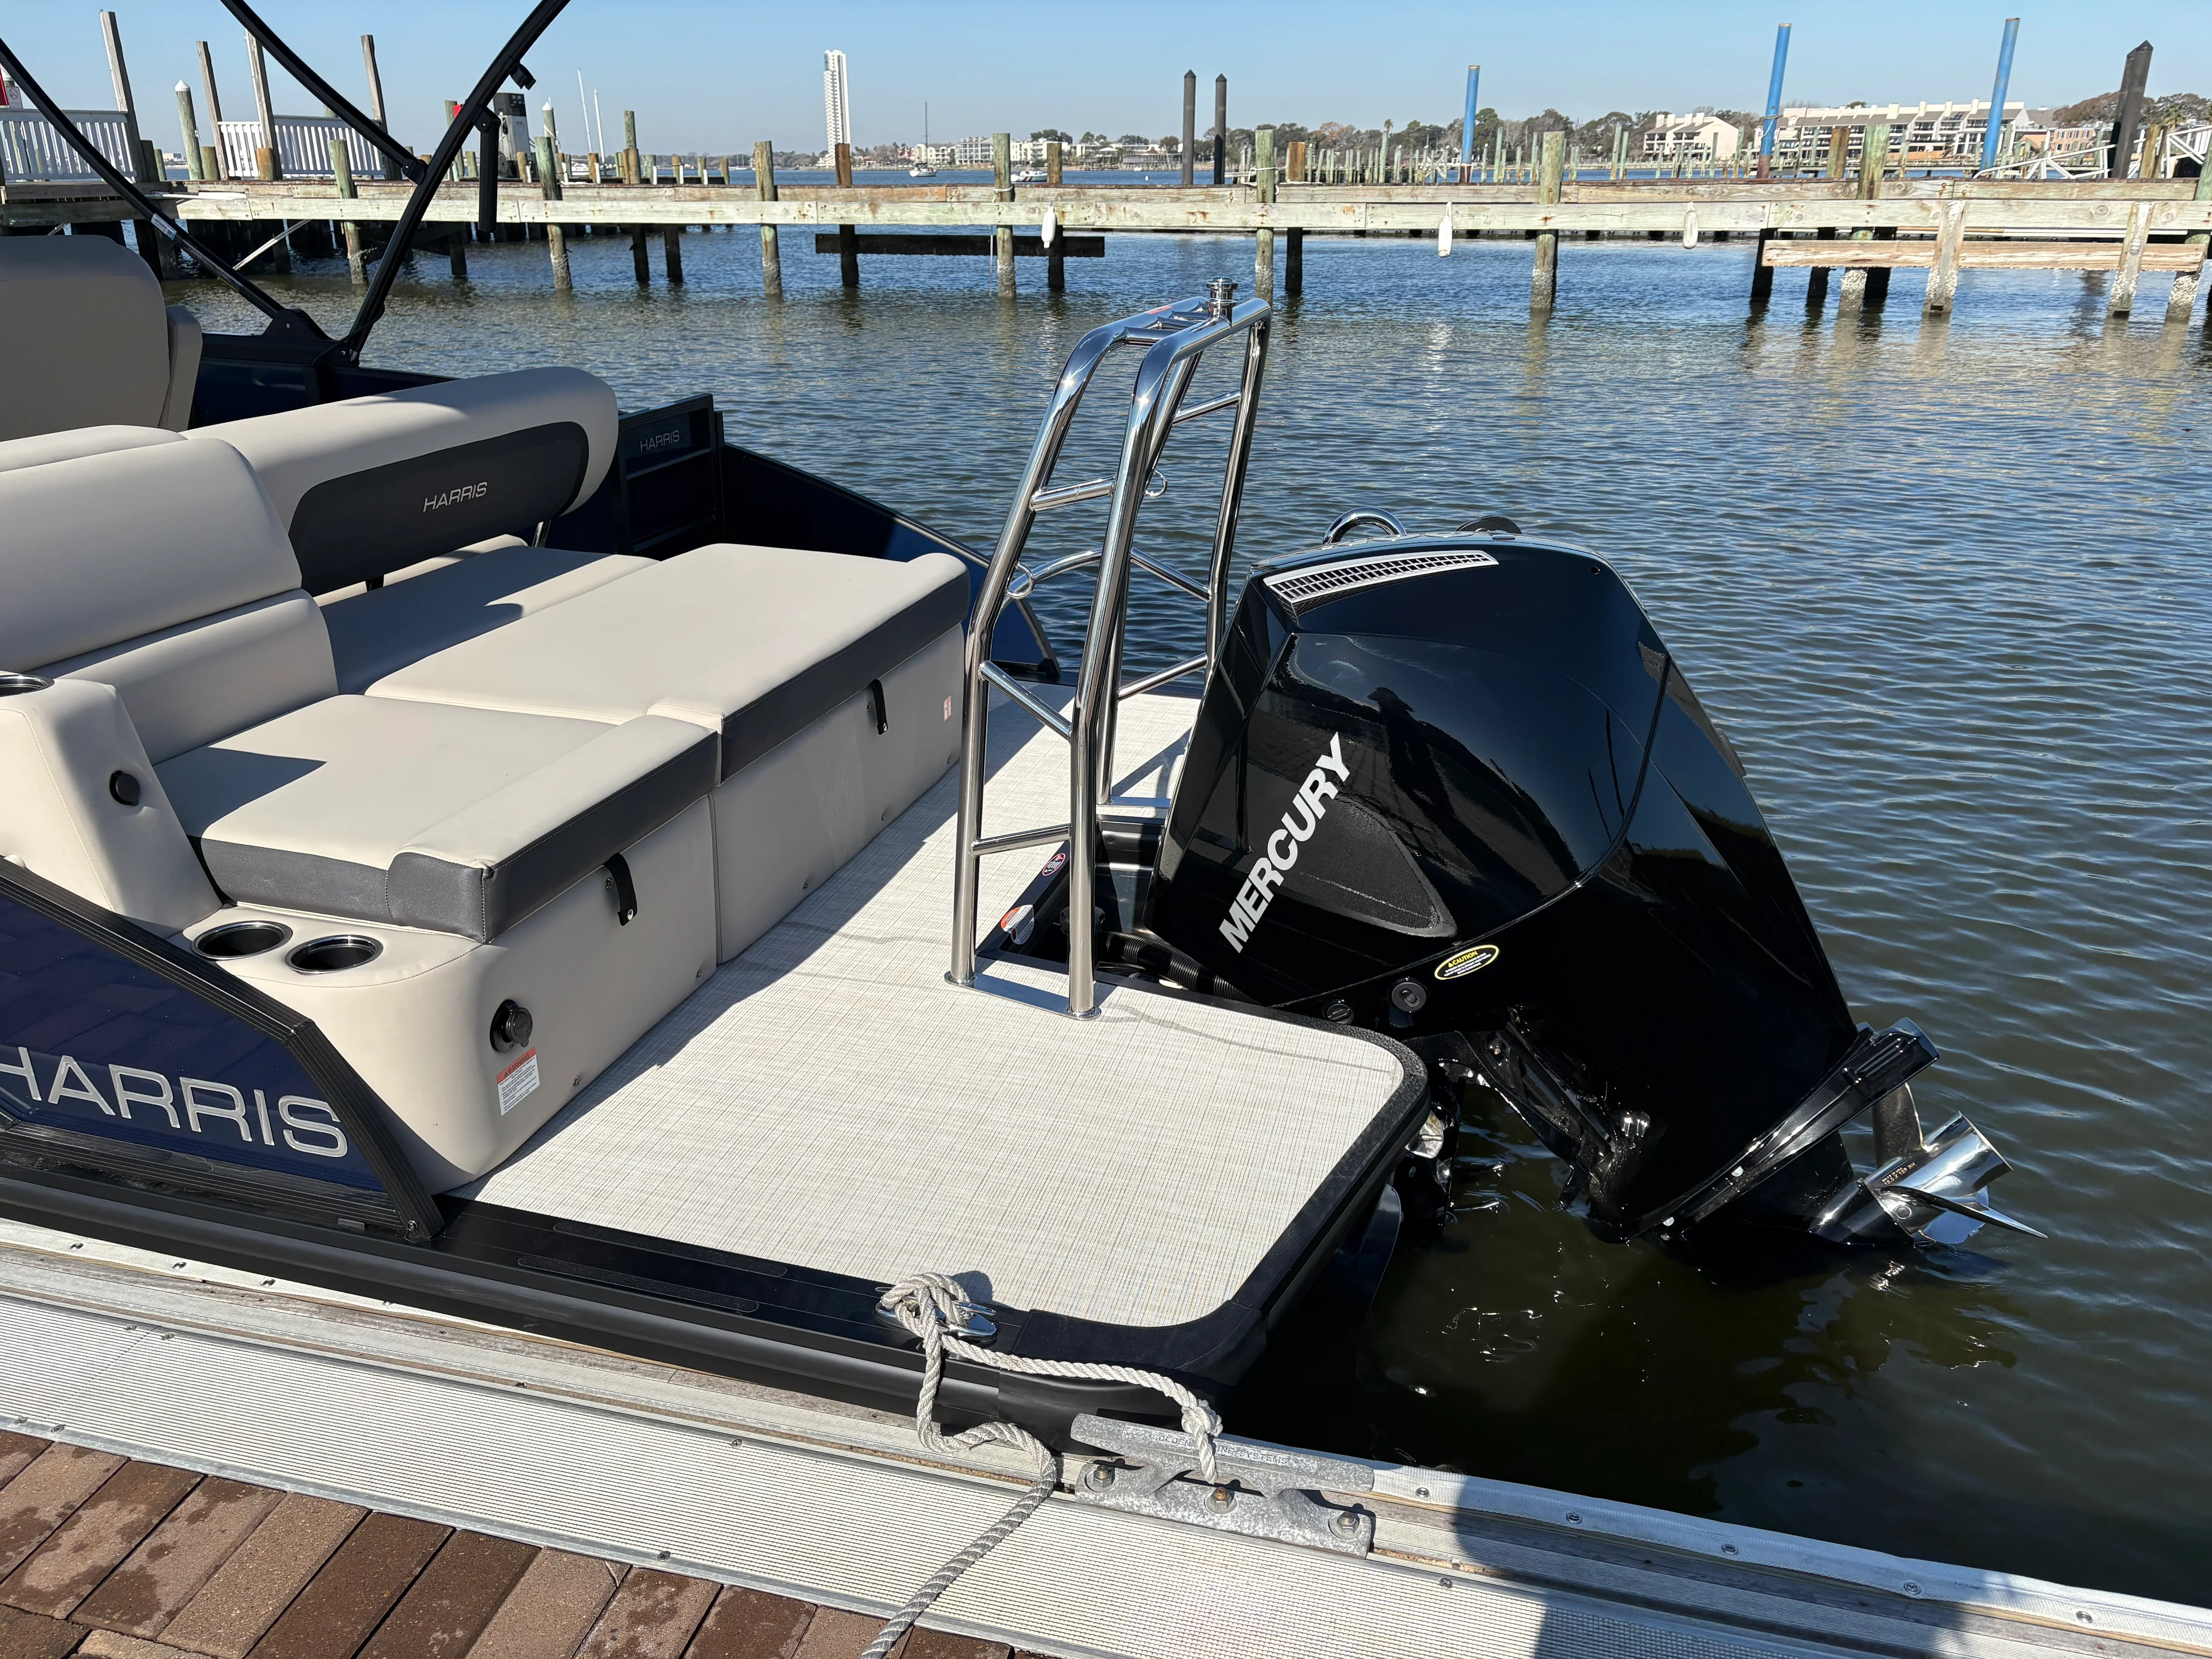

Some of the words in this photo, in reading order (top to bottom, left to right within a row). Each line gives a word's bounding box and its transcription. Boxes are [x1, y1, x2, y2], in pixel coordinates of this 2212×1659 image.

[640, 430, 680, 452] HARRIS
[423, 482, 488, 512] HARRIS
[1219, 732, 1350, 953] MERCURY
[1452, 951, 1478, 965] CAUTION
[507, 1054, 529, 1074] WARNING
[1152, 1433, 1192, 1448] GOLDEN
[1240, 1451, 1289, 1464] SYSTEMS
